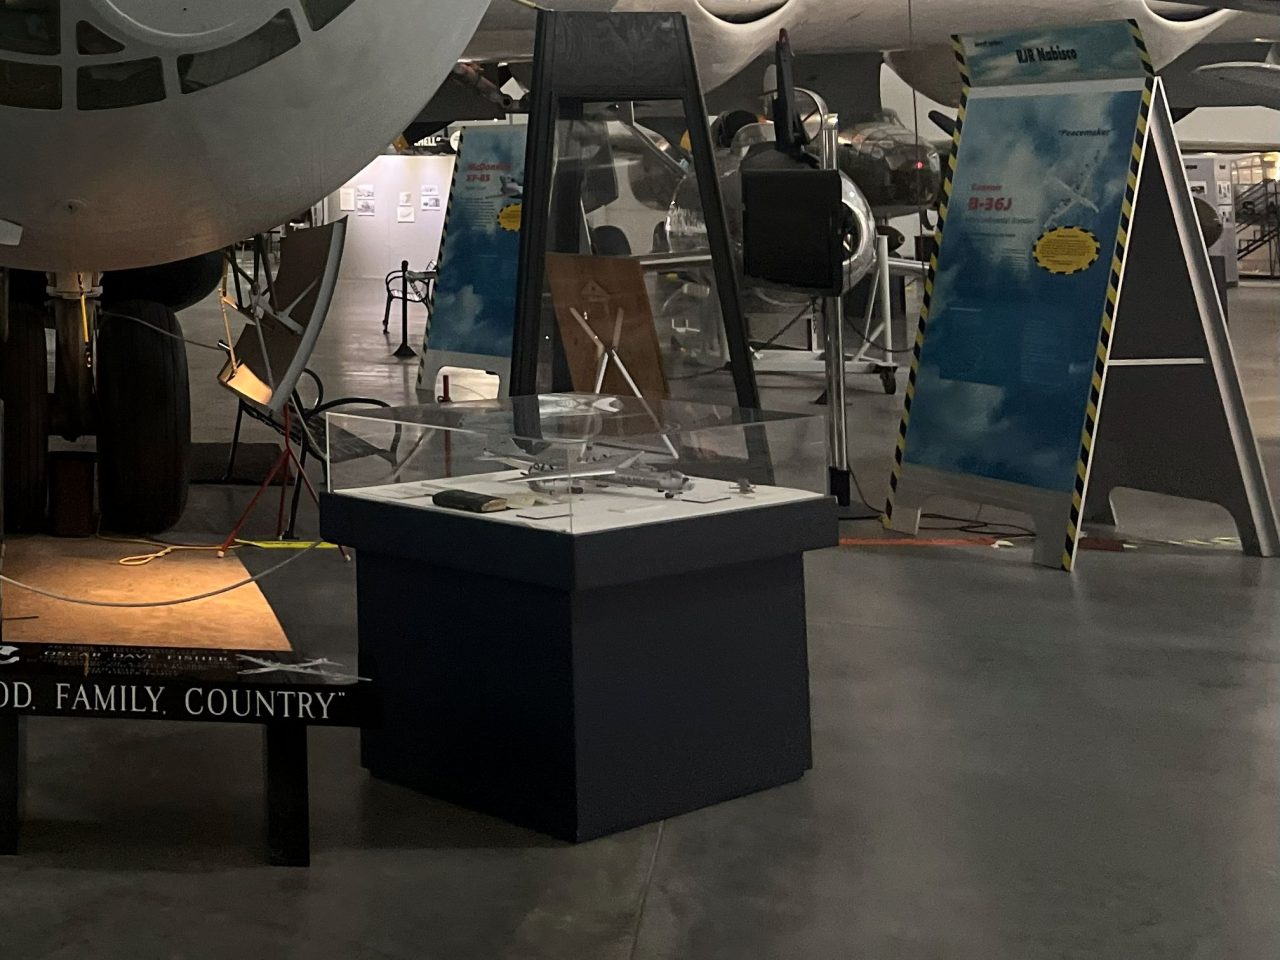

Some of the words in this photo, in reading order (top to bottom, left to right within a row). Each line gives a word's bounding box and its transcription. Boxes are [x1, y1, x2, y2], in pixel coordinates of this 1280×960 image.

[1016, 48, 1035, 64] RJR
[1036, 45, 1078, 61] Nabisco
[968, 197, 1012, 211] B-36J
[184, 687, 346, 720] COUNTRY"
